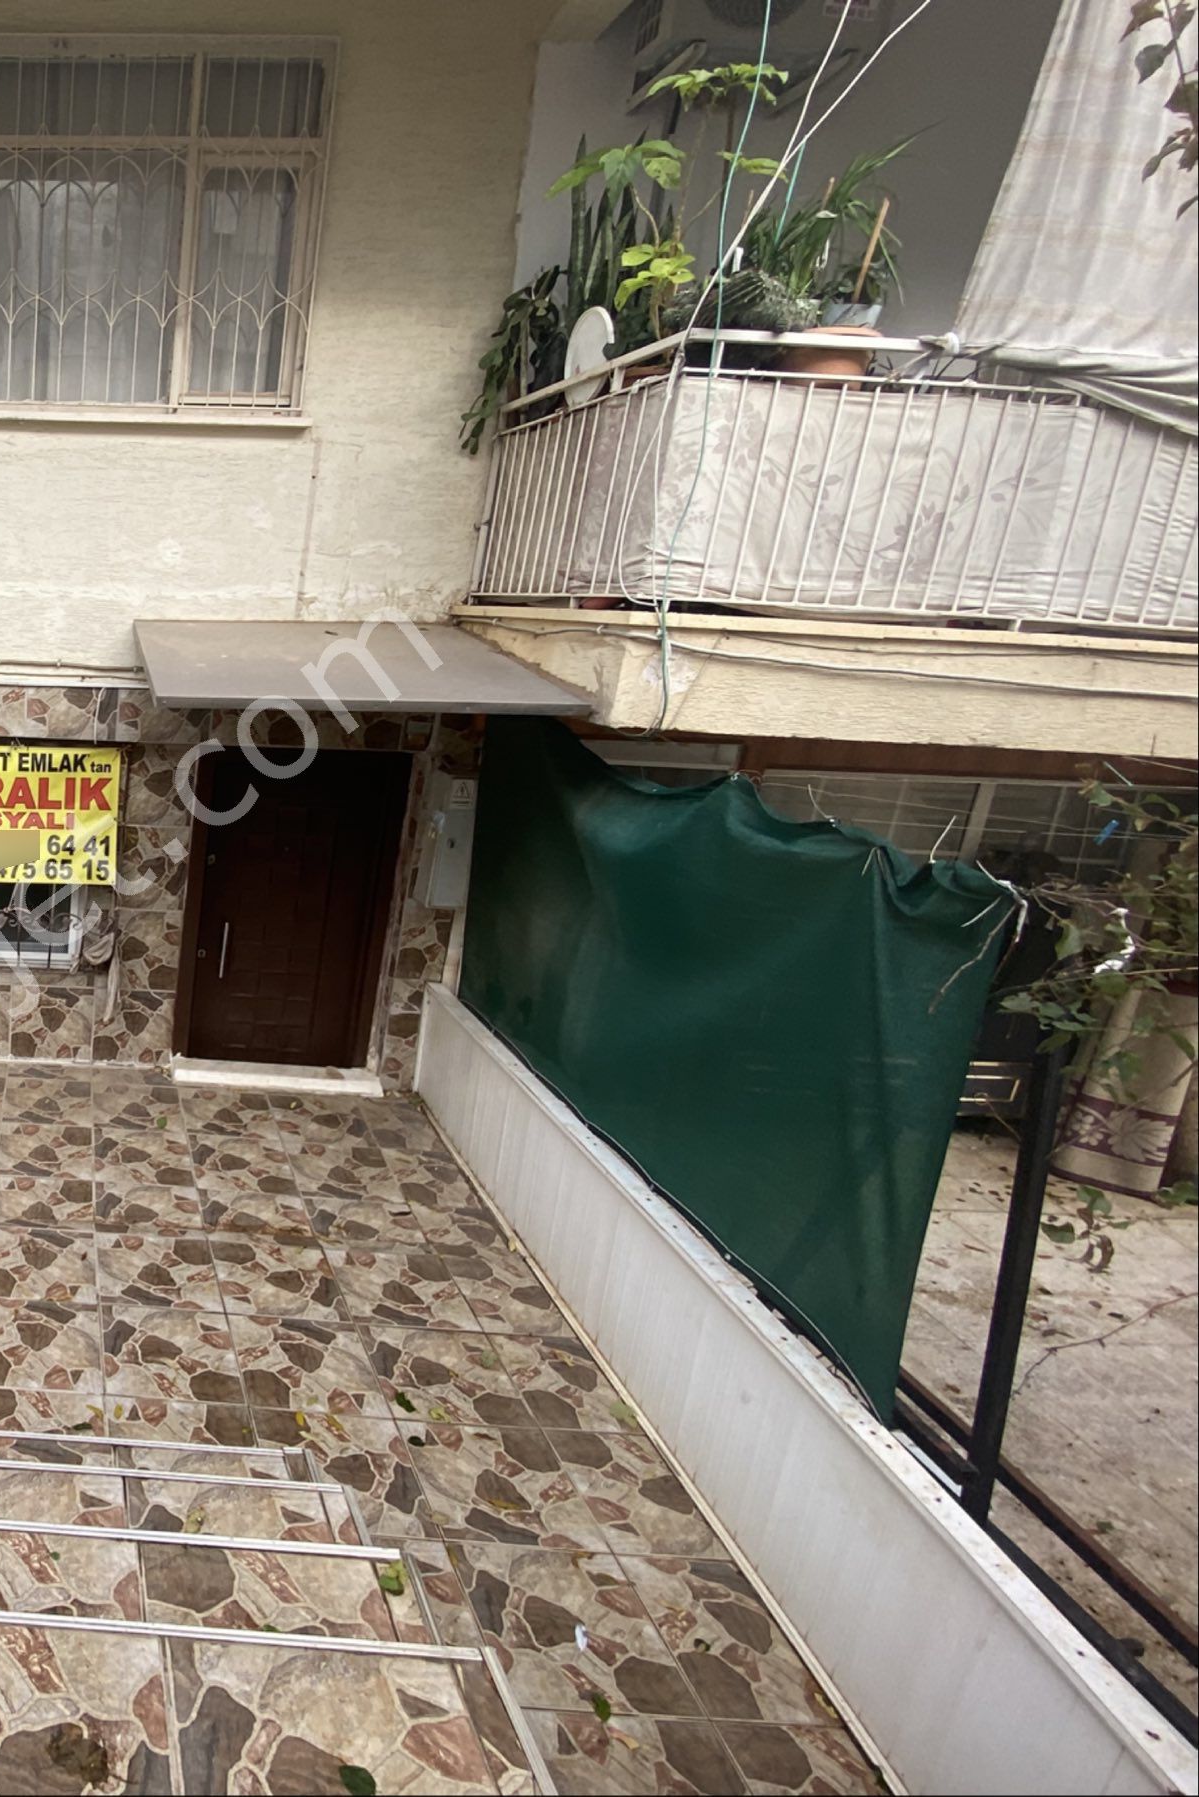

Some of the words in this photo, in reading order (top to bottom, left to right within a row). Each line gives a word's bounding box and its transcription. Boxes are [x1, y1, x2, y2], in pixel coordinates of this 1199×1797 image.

[47, 834, 75, 856] 64
[83, 835, 110, 856] 41
[44, 859, 73, 880] 65
[82, 860, 109, 880] 15
